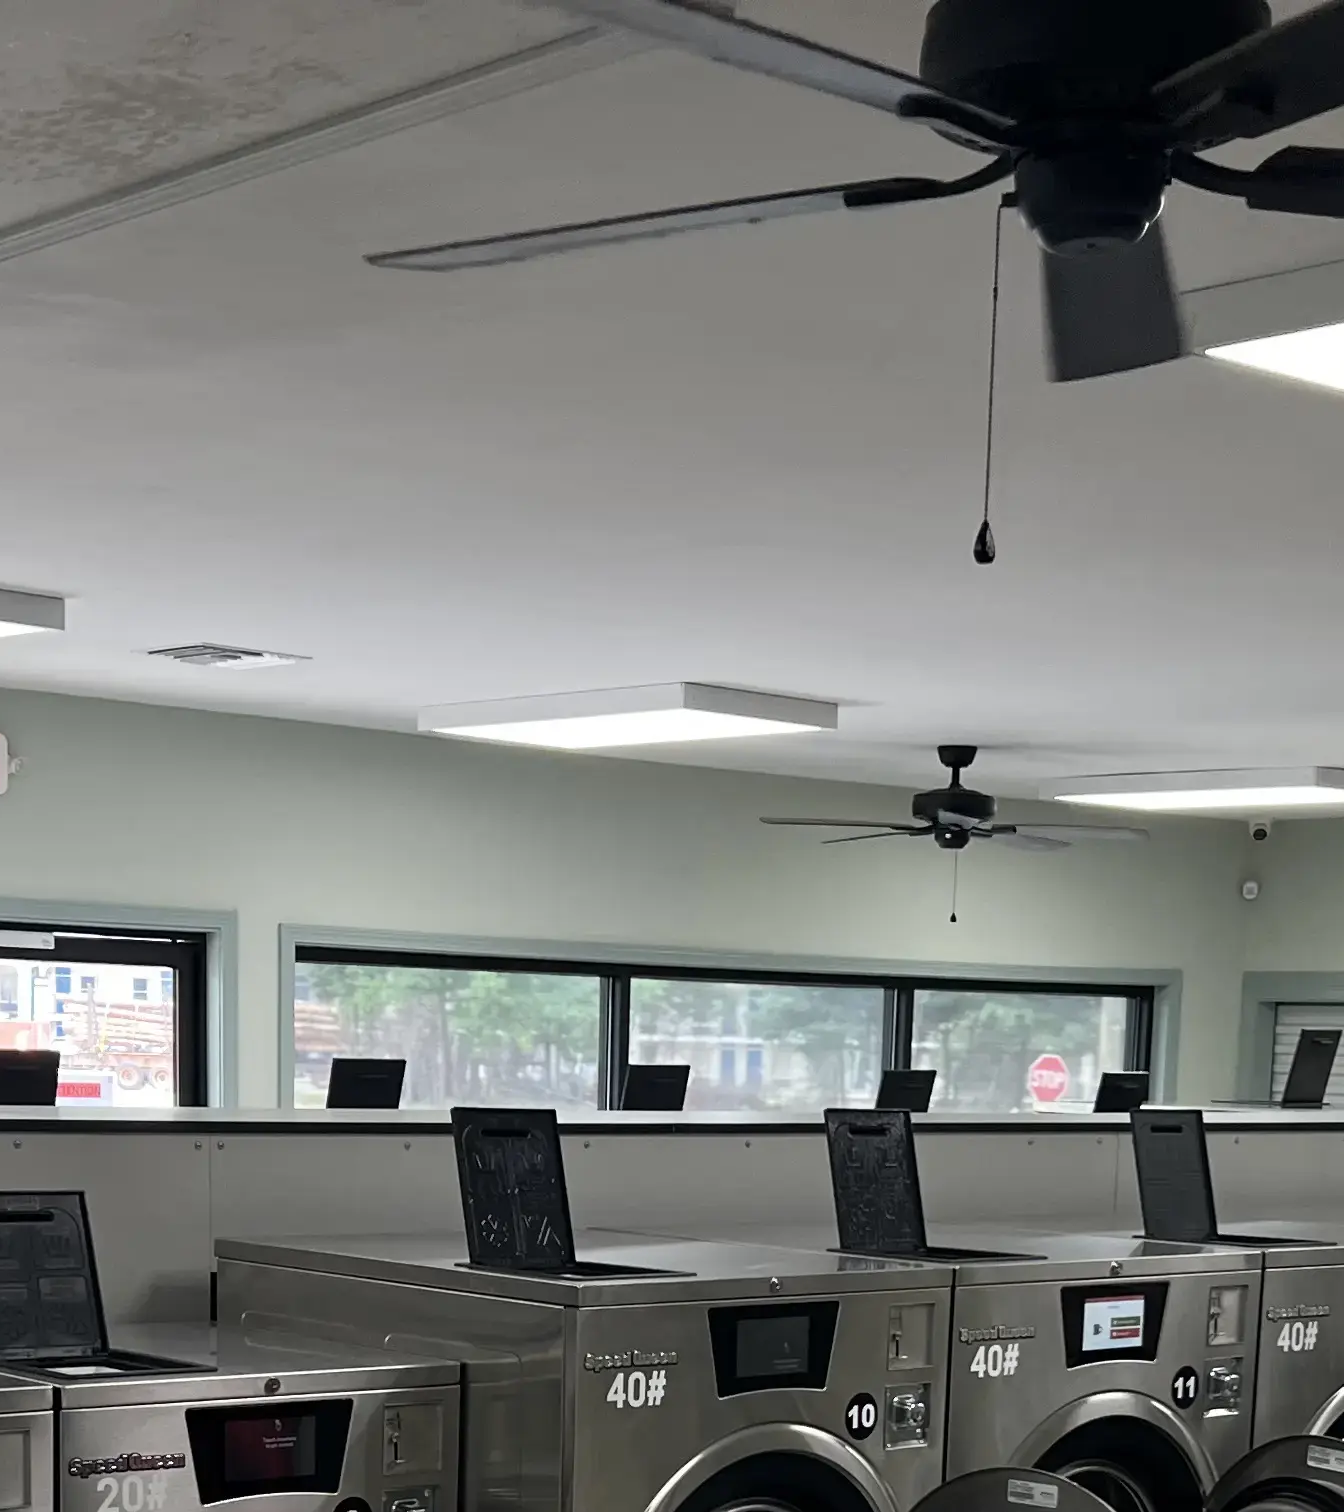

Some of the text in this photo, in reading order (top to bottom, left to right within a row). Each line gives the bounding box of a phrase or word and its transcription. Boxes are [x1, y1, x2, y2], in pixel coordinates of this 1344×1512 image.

[1031, 1069, 1065, 1090] STOP
[1276, 1320, 1318, 1353] 40#
[970, 1343, 1019, 1378] 40#
[606, 1369, 667, 1408] 40#
[1173, 1375, 1196, 1399] 11
[847, 1402, 876, 1430] 10
[68, 1452, 186, 1479] Speed Queen
